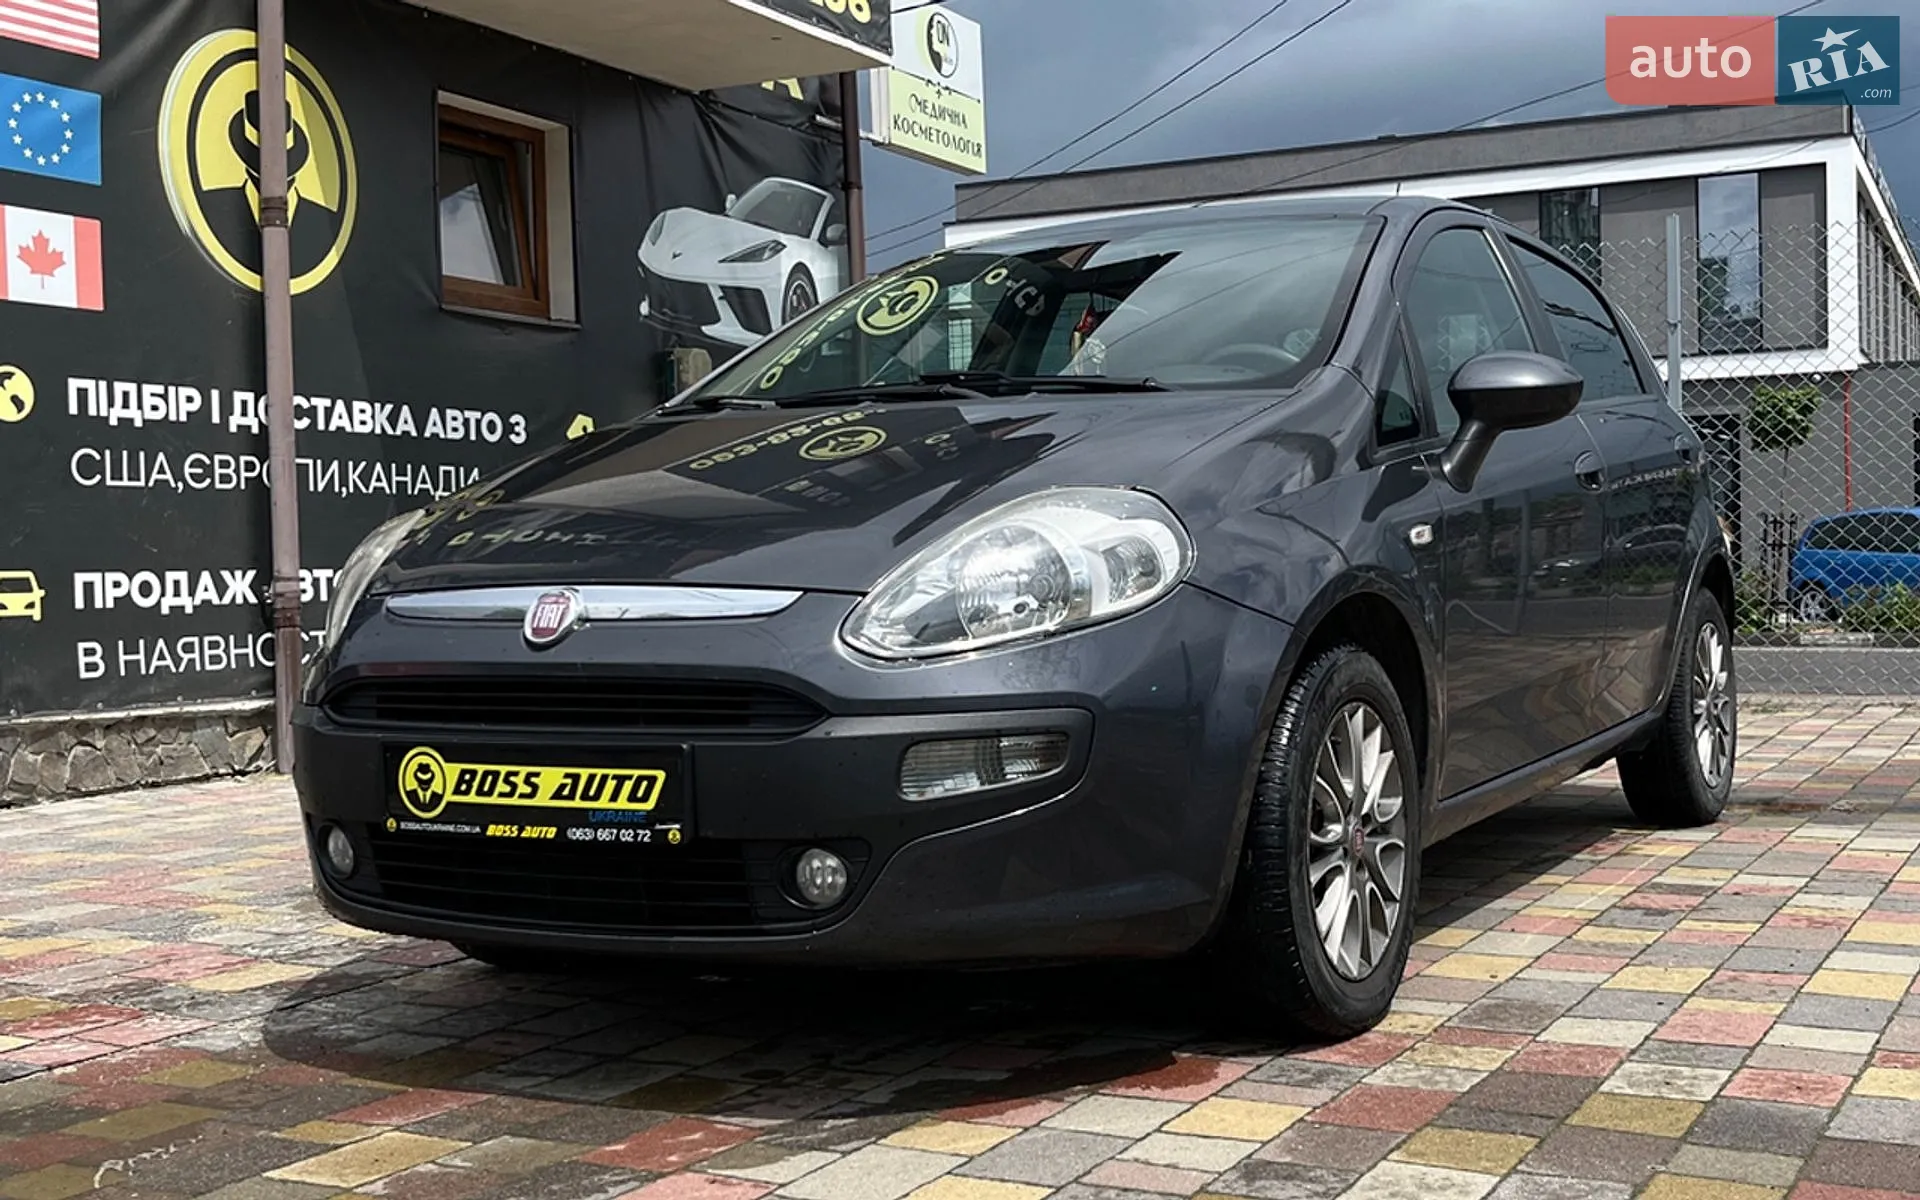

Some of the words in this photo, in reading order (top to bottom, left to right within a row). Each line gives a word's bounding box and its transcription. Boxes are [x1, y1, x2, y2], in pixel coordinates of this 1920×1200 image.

[893, 113, 982, 158] КОСМЕТОЛОГІЯ
[67, 377, 202, 427] ПІДБІР
[228, 390, 417, 437] ДСТАВКА
[424, 407, 503, 442] АВТО
[70, 447, 480, 501] США,ЄВРПИ,КАНАДИ
[73, 569, 258, 614] ПРОДАЖ
[533, 603, 568, 629] FIAT
[77, 641, 105, 679] В
[452, 768, 542, 800] BOSS
[549, 773, 659, 804] AUTO
[486, 824, 519, 837] BOSS
[520, 826, 557, 839] AUTO
[566, 827, 595, 841] (063)
[597, 828, 618, 841] 667
[619, 829, 635, 842] 02
[636, 830, 651, 843] 72
[588, 811, 648, 823] UKRAINE
